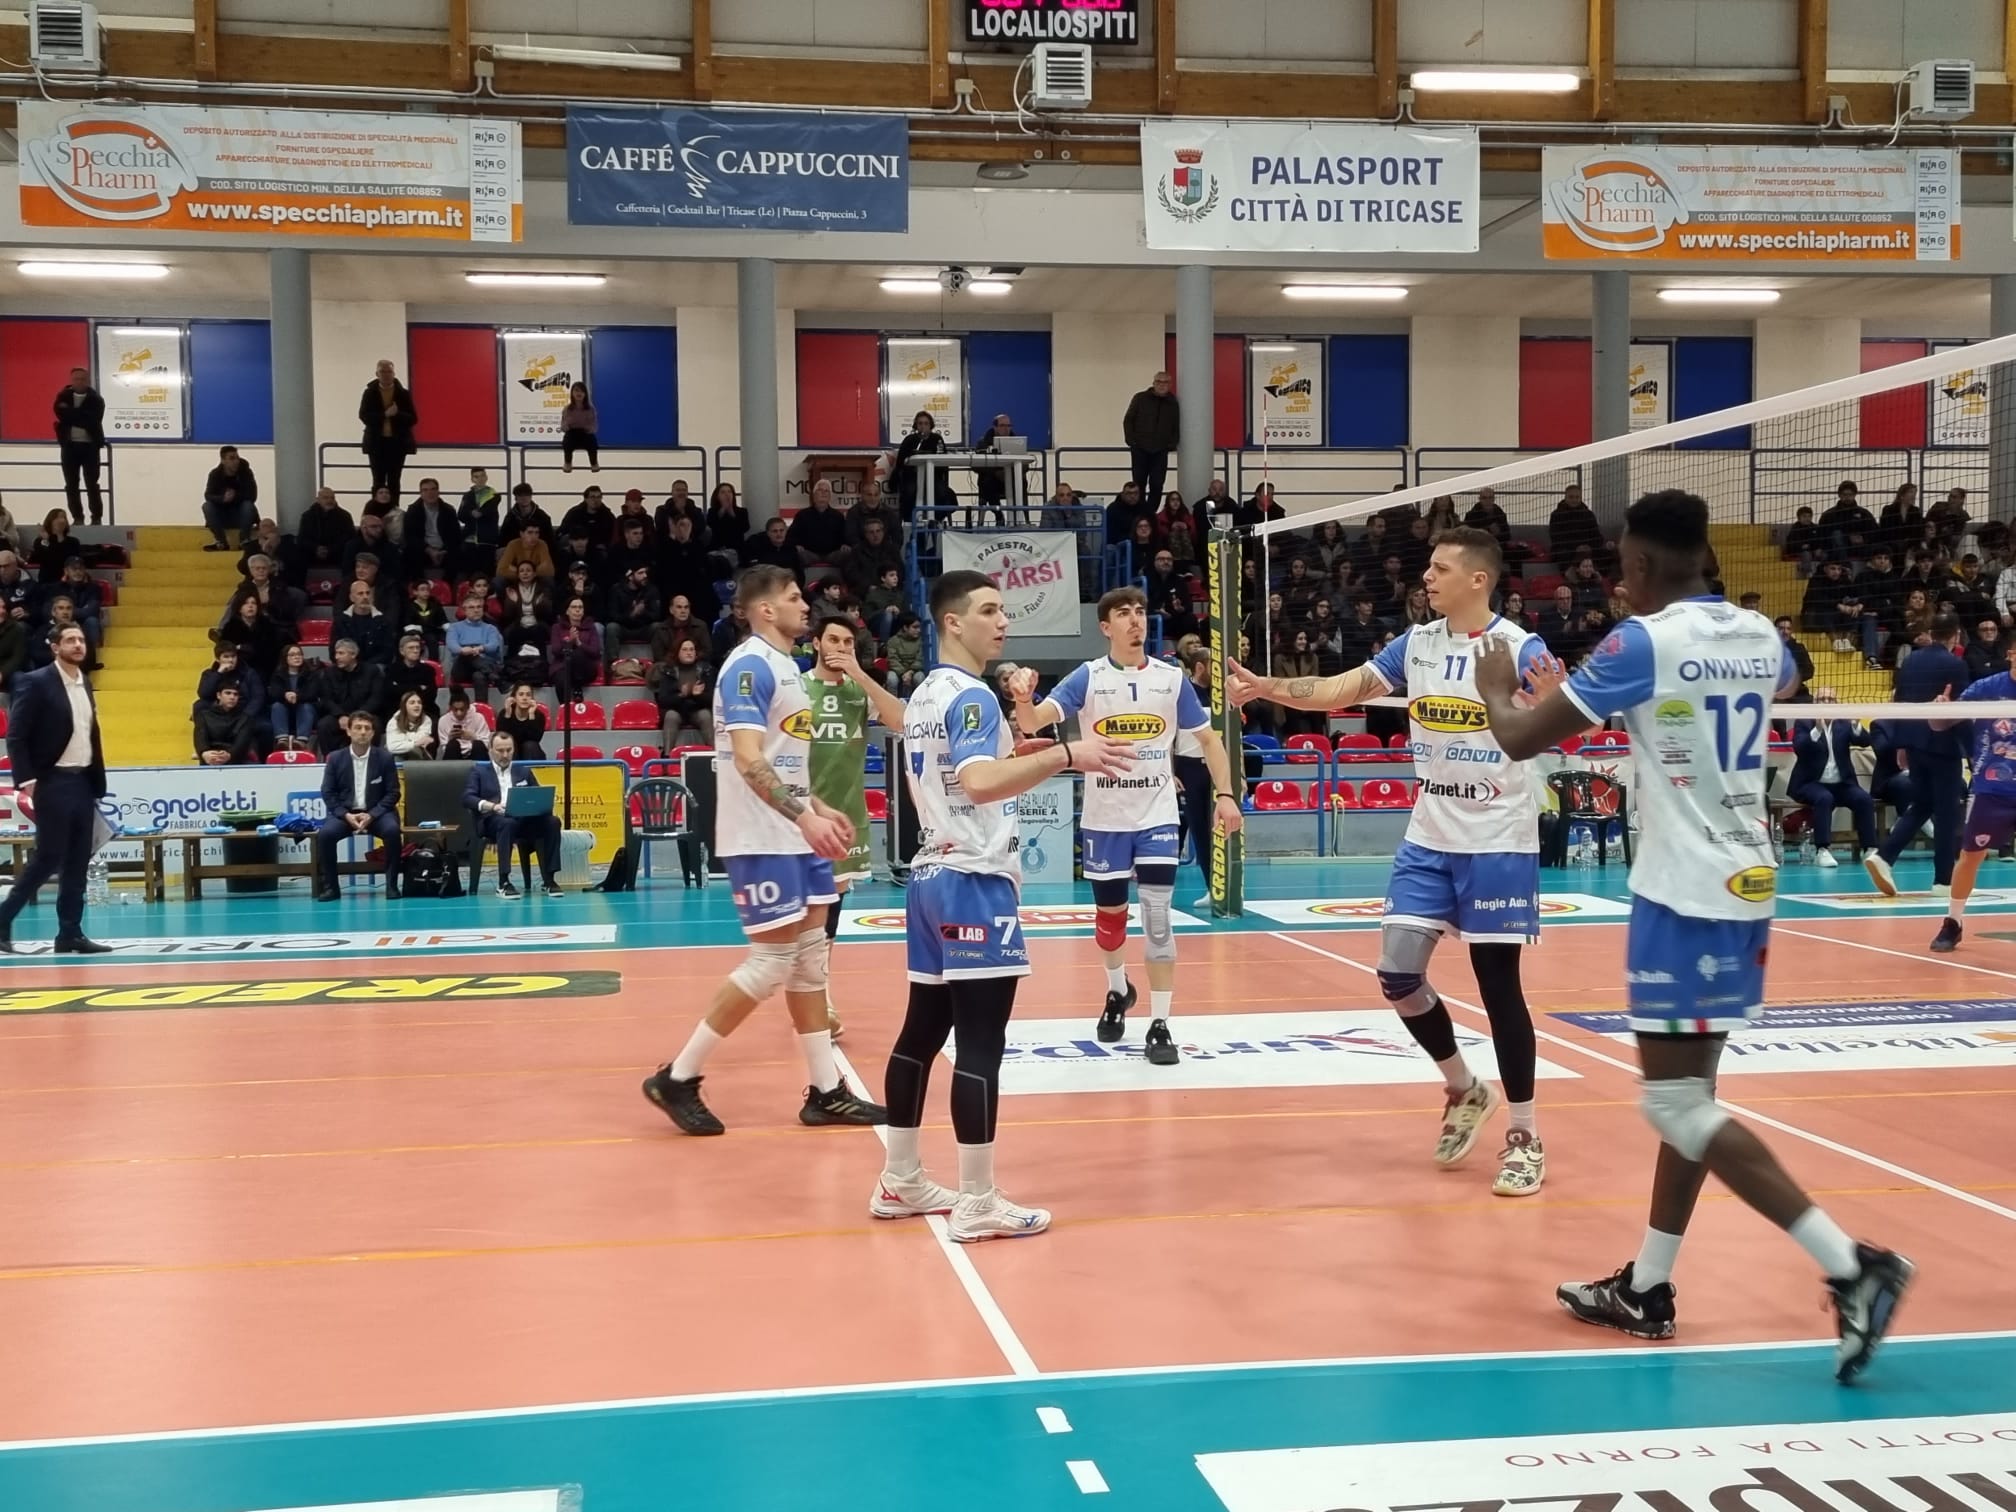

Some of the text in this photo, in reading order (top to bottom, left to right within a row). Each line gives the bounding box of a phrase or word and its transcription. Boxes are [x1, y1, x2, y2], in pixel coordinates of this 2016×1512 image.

[56, 141, 171, 170] Specchia
[716, 150, 900, 178] CAPPUCCINI
[71, 147, 156, 189] Pharm
[1252, 156, 1443, 186] PALASPORT
[210, 180, 232, 189] COD.
[234, 181, 256, 190] SITO
[258, 181, 309, 192] LOGISTICO
[311, 185, 331, 193] MIN.
[333, 185, 365, 195] DELLA
[367, 186, 405, 196] SALUTE
[1572, 181, 1667, 204] Specchia
[187, 202, 463, 229] www.specchiapharm.it
[667, 204, 704, 215] Cocktail
[706, 205, 720, 215] Bar
[727, 206, 756, 216] Tricase
[757, 206, 775, 217] (Le)
[783, 207, 808, 217] Piazza
[809, 208, 859, 220] Cappuccini,
[860, 210, 867, 219] 3
[1230, 193, 1463, 223] CITTÀ DI TRICASE
[1584, 187, 1654, 223] Pharm
[1697, 213, 1718, 222] COD.
[1719, 213, 1738, 222] SITO
[1740, 213, 1780, 222] LOGISTICO
[1781, 213, 1799, 222] MIN.
[1801, 214, 1823, 222] DELLA
[1825, 214, 1861, 222] SALUTE
[1679, 230, 1910, 252] www.specchiapharm.it
[977, 541, 1034, 561] PALESTRA
[1210, 542, 1221, 619] BANCA
[1211, 627, 1222, 716] CREDEM
[1444, 655, 1468, 681] 11
[1127, 682, 1138, 702] 1
[822, 695, 838, 713] 8
[1704, 692, 1763, 773] 12
[1446, 748, 1501, 762] CAVI
[100, 790, 257, 829] Spagnoletti
[289, 798, 327, 821] 139
[1019, 807, 1058, 816] SERIE A
[169, 819, 208, 830] FABBRICA
[743, 881, 781, 906] 10
[958, 927, 984, 942] LAB
[994, 916, 1018, 945] 7
[1504, 1444, 1722, 1467] FORNO
[1739, 1439, 1824, 1454] DA
